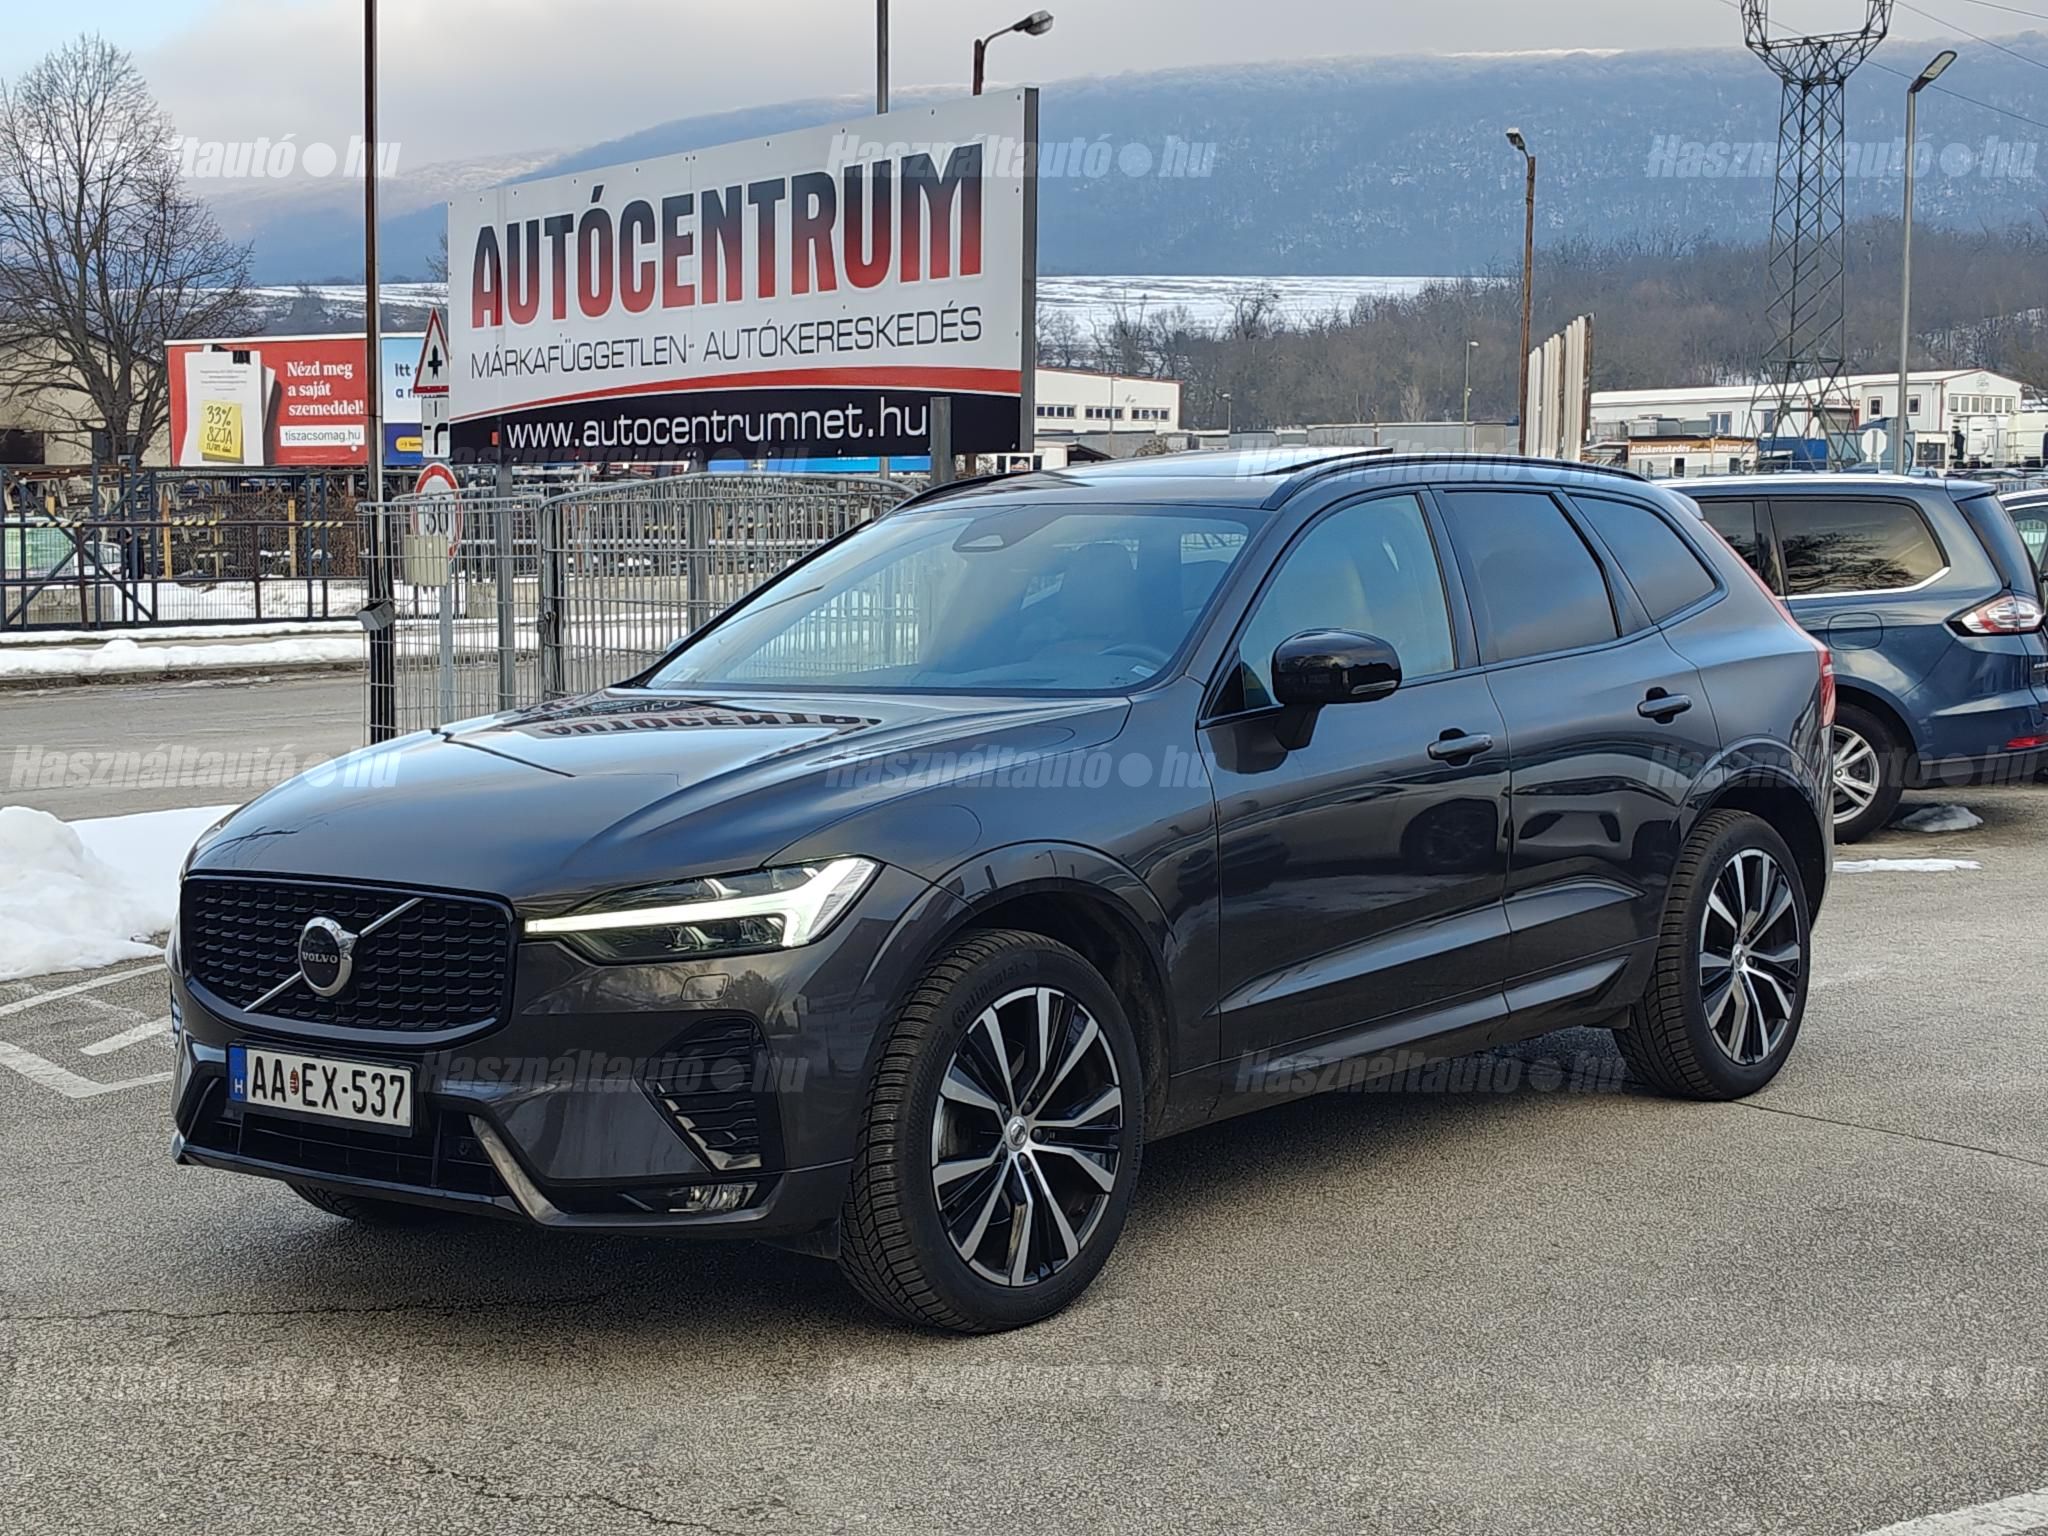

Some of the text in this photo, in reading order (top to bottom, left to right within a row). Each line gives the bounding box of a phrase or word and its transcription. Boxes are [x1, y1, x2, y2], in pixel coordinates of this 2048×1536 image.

[471, 142, 983, 330] AUTÓCENTRUM
[703, 301, 982, 363] AUTÓKERESKEDÉS
[287, 361, 353, 380] Nézd meg
[395, 363, 411, 376] Itt
[287, 380, 332, 400] a saját
[206, 404, 233, 428] 33%
[288, 400, 364, 416] szemeddel!
[506, 396, 928, 449] www.autocentrumnet.hu
[206, 426, 233, 446] SZJA
[284, 430, 361, 442] tiszacsomag.hu
[302, 951, 338, 964] VOLVO
[234, 1077, 244, 1094] H
[251, 1055, 406, 1119] AA EX-537
